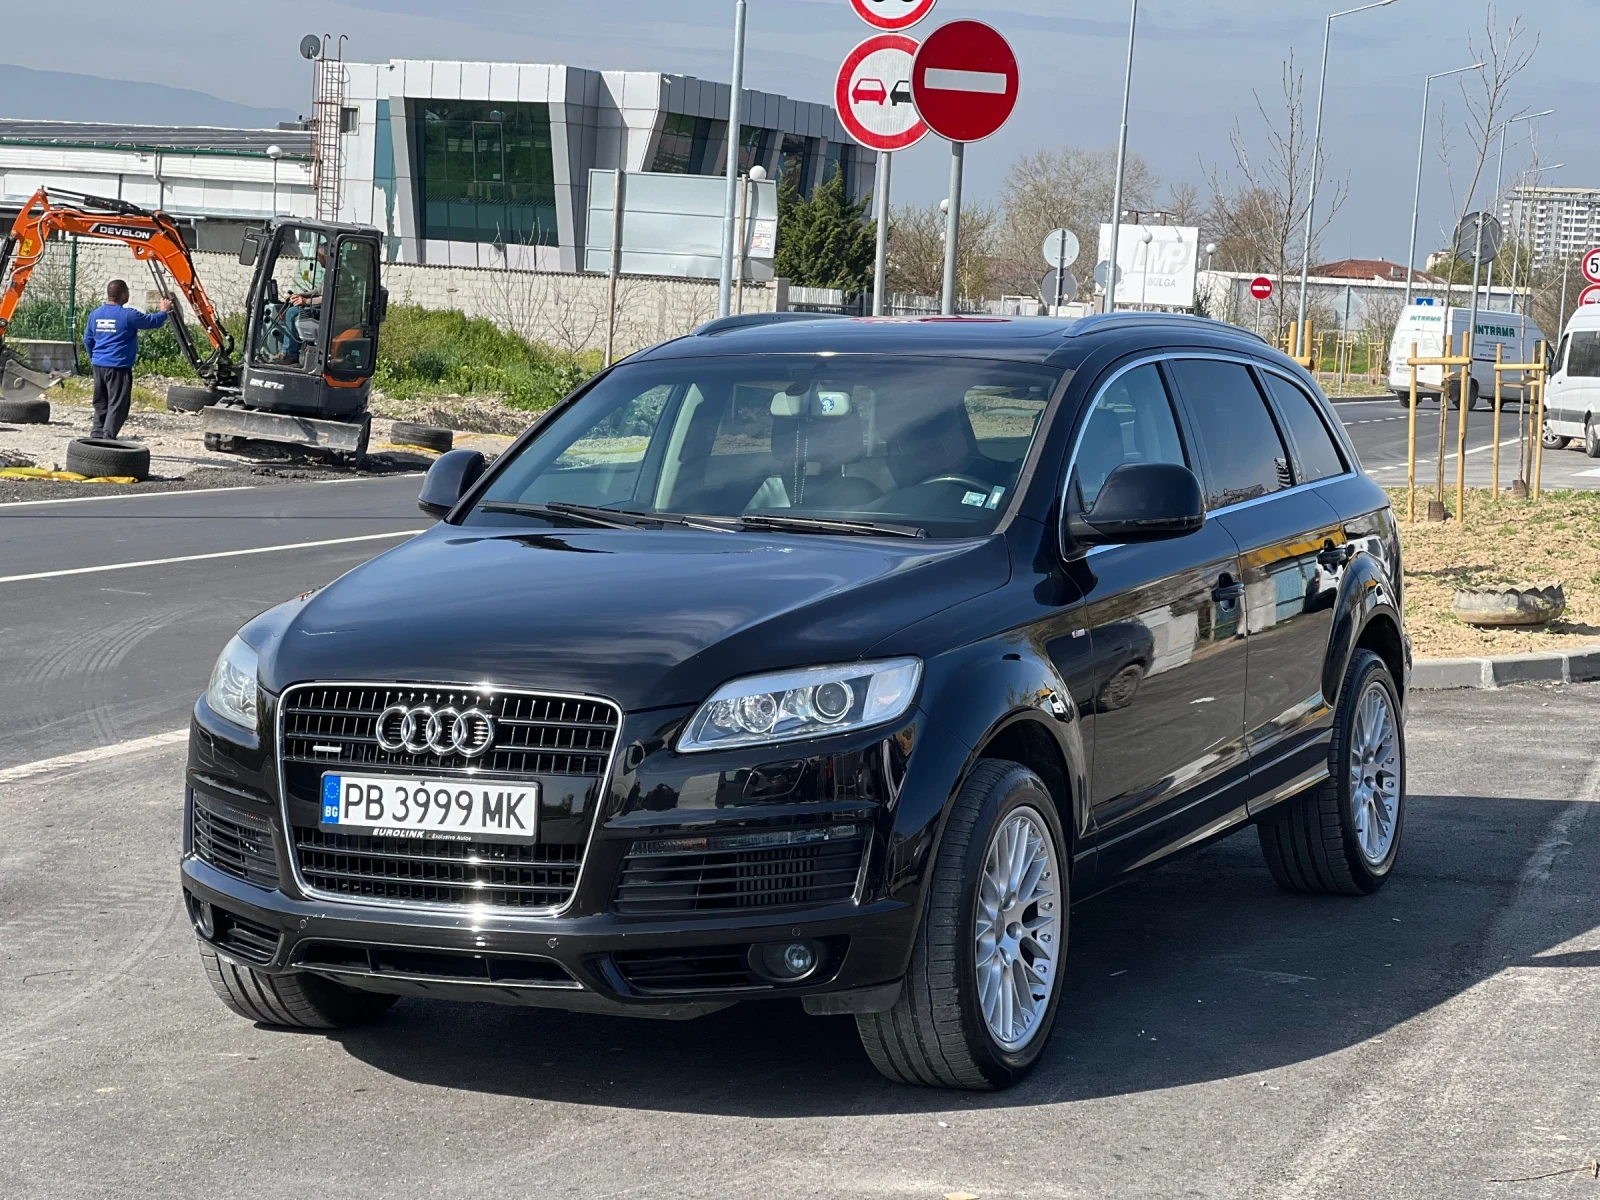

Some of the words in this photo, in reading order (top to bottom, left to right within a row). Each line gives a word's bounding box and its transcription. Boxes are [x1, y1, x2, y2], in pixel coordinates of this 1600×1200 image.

[99, 226, 150, 239] DEVELON
[1590, 257, 1600, 274] 5
[325, 805, 339, 818] BG
[344, 783, 385, 821] PB
[392, 786, 473, 826] 3999
[481, 790, 528, 830] MK
[372, 828, 425, 839] EUROLINK
